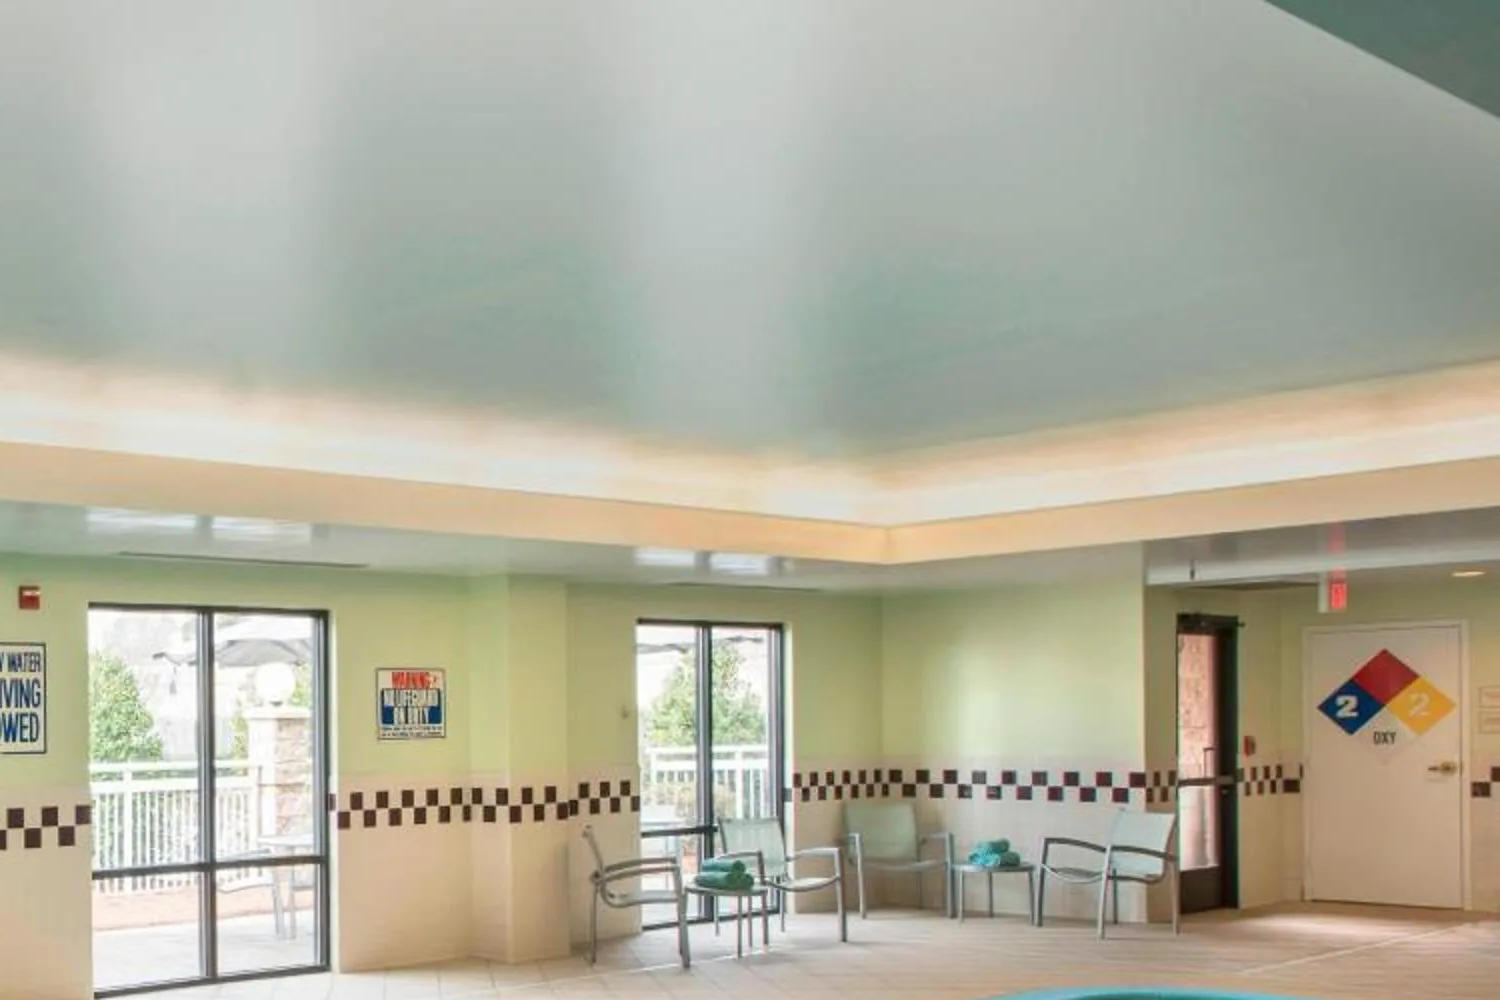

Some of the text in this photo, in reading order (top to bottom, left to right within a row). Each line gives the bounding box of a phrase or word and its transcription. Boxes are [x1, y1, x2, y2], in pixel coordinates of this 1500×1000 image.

[8, 652, 40, 672] WATER
[1335, 695, 1359, 718] 2
[1408, 693, 1431, 717] 2
[1373, 731, 1396, 745] OXY
